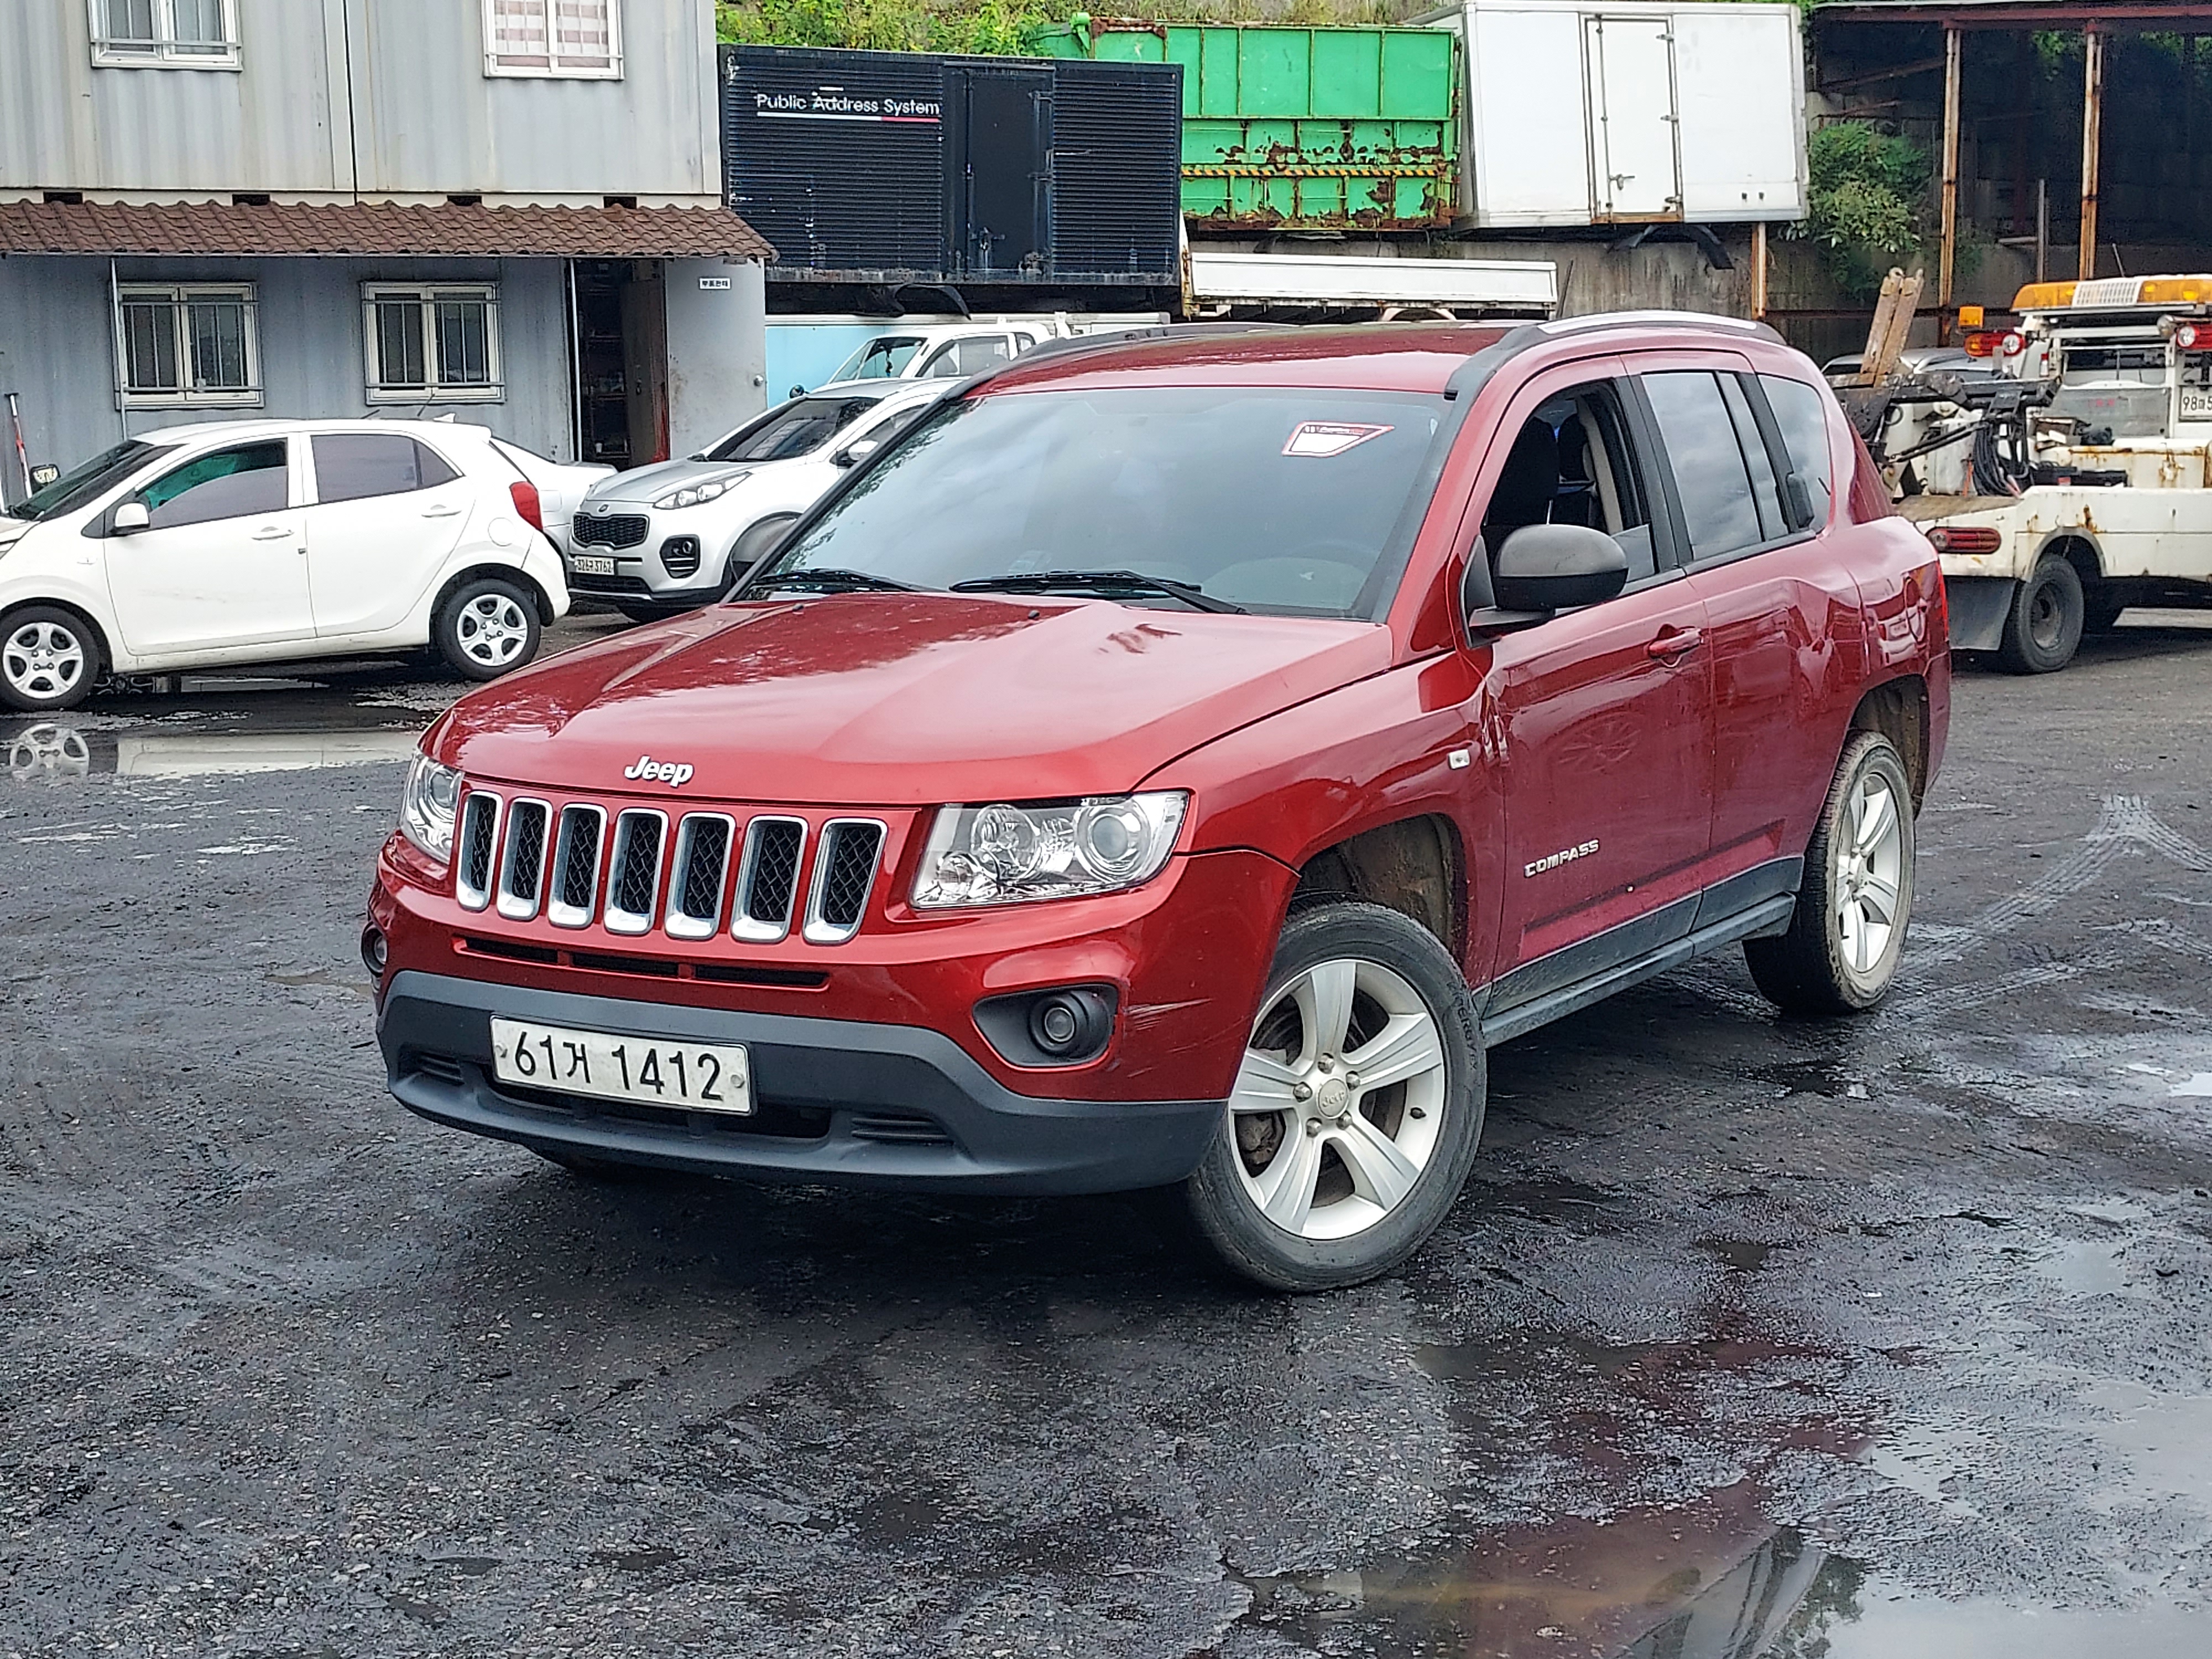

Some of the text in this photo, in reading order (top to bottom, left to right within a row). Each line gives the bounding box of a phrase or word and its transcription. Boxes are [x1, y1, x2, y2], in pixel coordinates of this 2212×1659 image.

[757, 93, 940, 117] Public Address System
[624, 755, 694, 788] Jeep
[1524, 838, 1600, 878] COMPASS
[514, 1031, 724, 1102] 61거 1412
